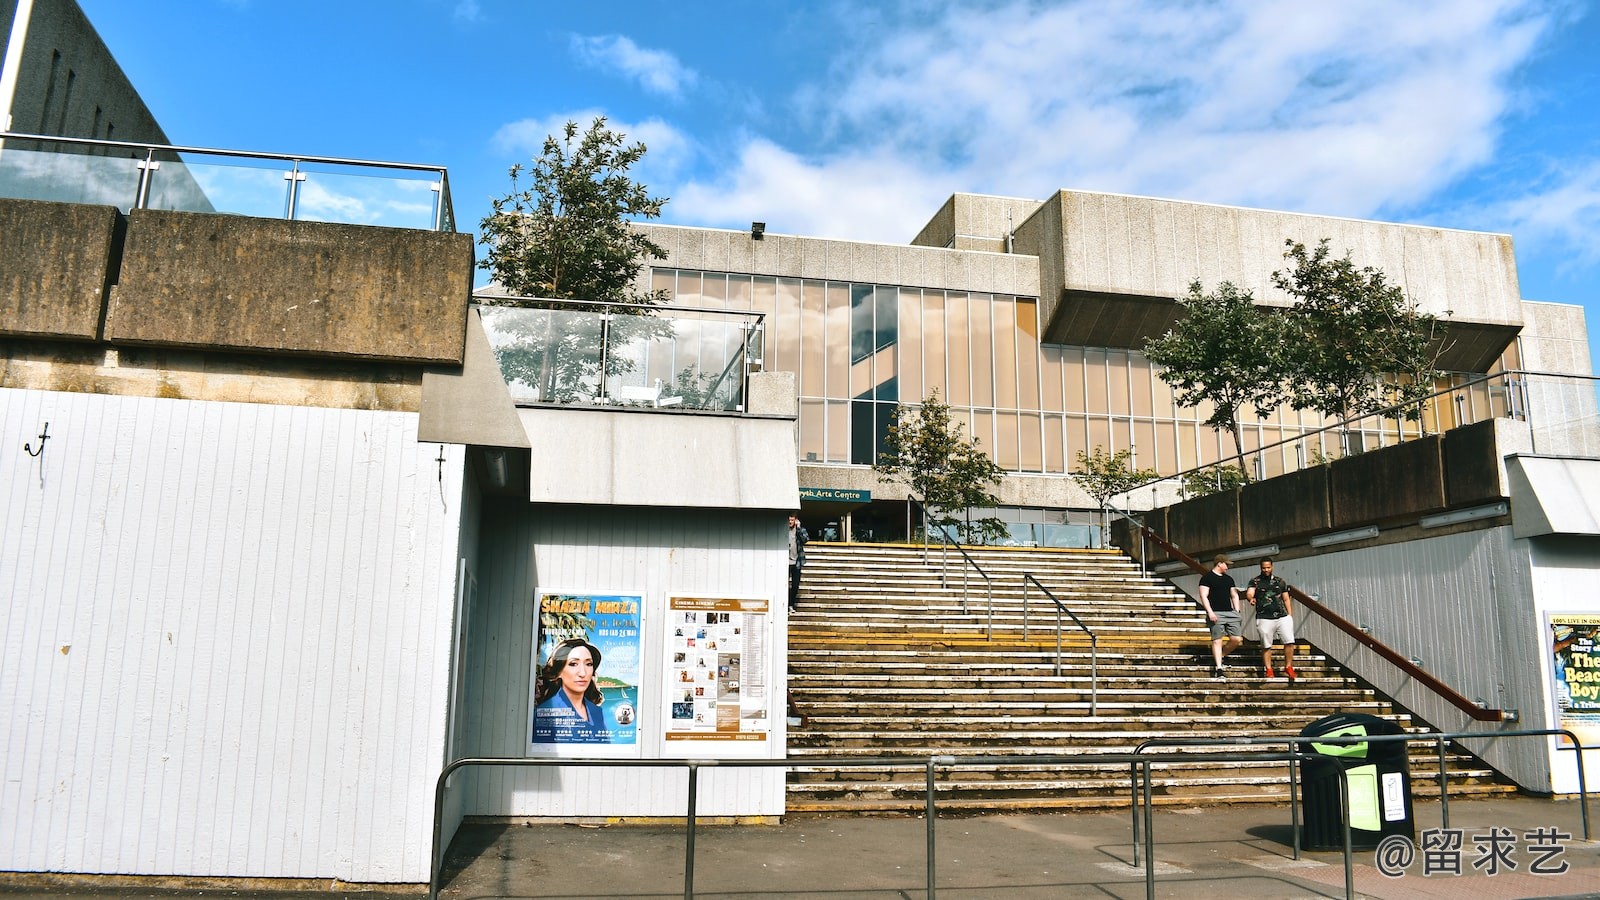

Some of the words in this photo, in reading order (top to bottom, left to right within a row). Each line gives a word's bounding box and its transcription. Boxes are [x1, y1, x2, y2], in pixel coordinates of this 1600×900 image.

[541, 599, 590, 613] SHAZIA
[595, 601, 637, 614] MIRZA
[1571, 644, 1592, 653] Story
[1571, 653, 1600, 667] The
[1564, 667, 1600, 682] Beac
[1569, 682, 1599, 700] Boy
